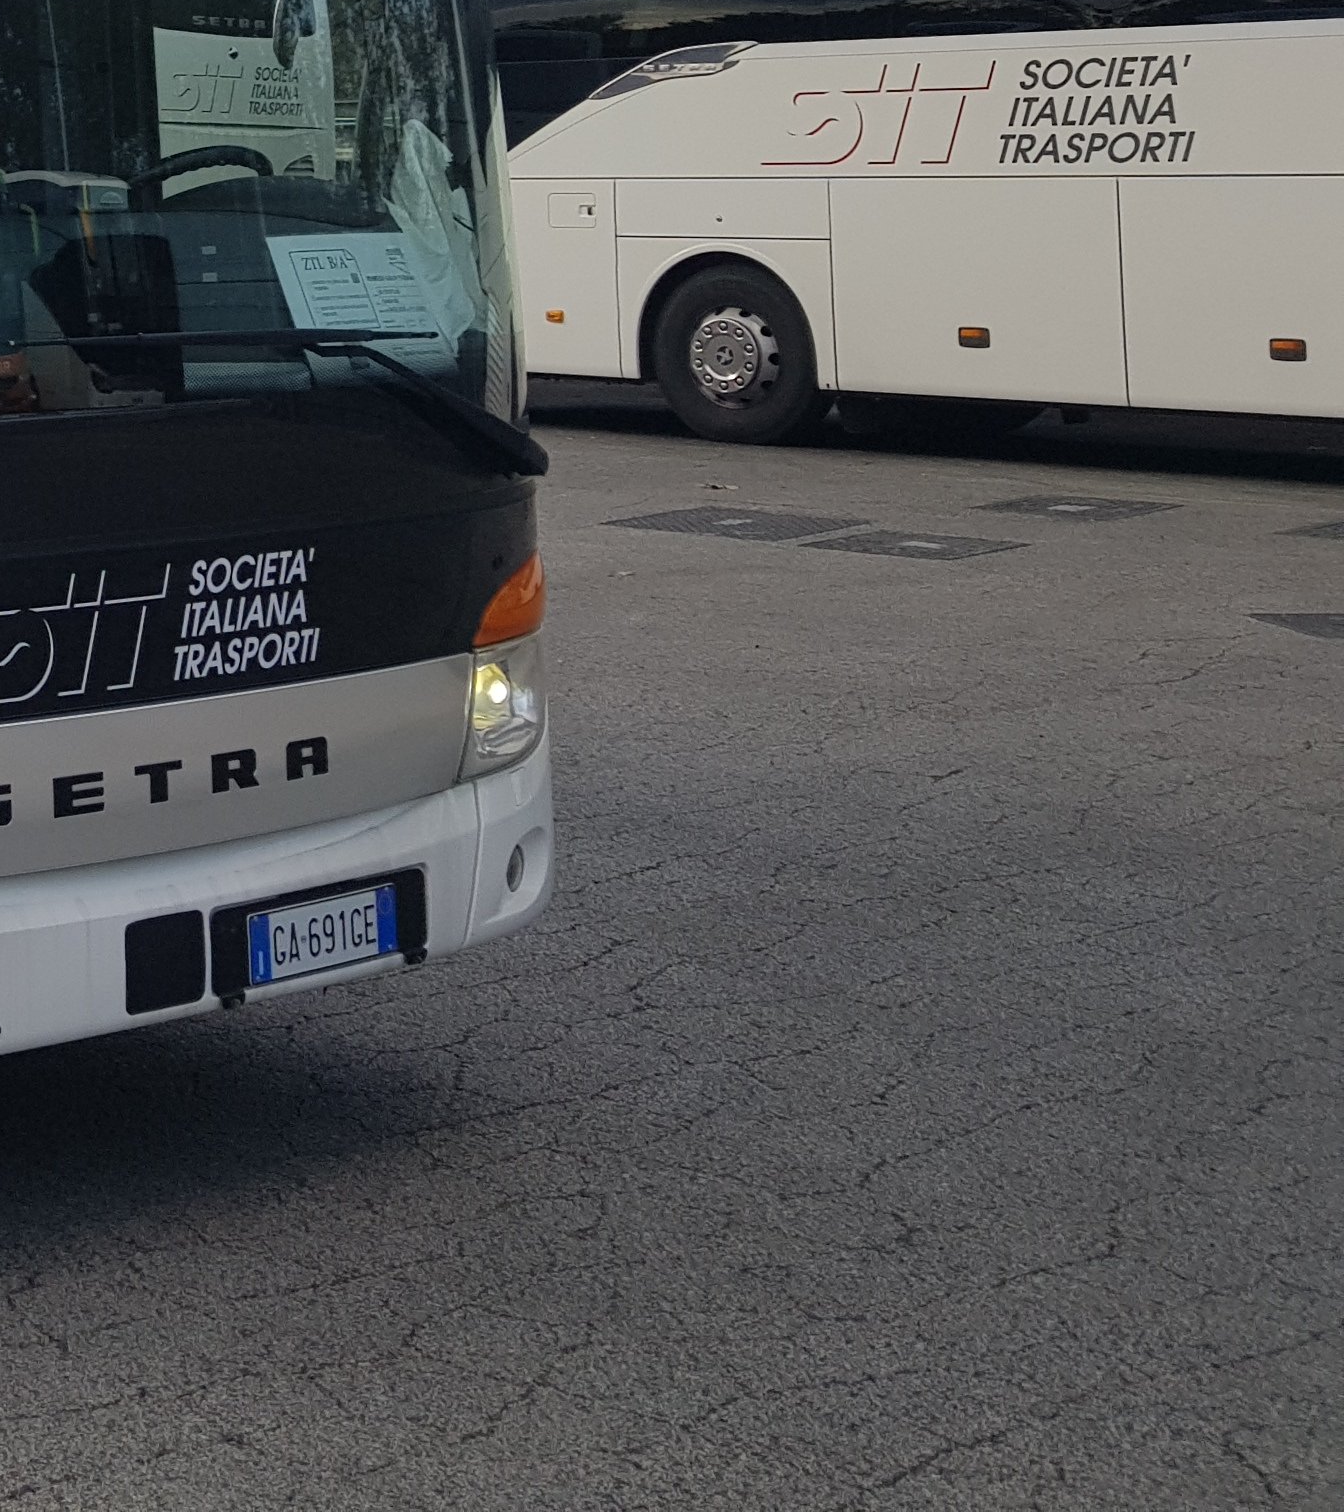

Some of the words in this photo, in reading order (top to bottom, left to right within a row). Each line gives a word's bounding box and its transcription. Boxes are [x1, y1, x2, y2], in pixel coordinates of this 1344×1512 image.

[1018, 54, 1191, 91] SOCIETA'
[251, 84, 299, 99] ITALIANA
[1008, 94, 1178, 128] ITALIANA
[997, 130, 1196, 165] TRASPORTI
[301, 256, 325, 271] ZTL
[188, 547, 316, 596] SOCIETA'
[180, 590, 308, 638] ITALIANA
[172, 627, 320, 681] TRASPORTI
